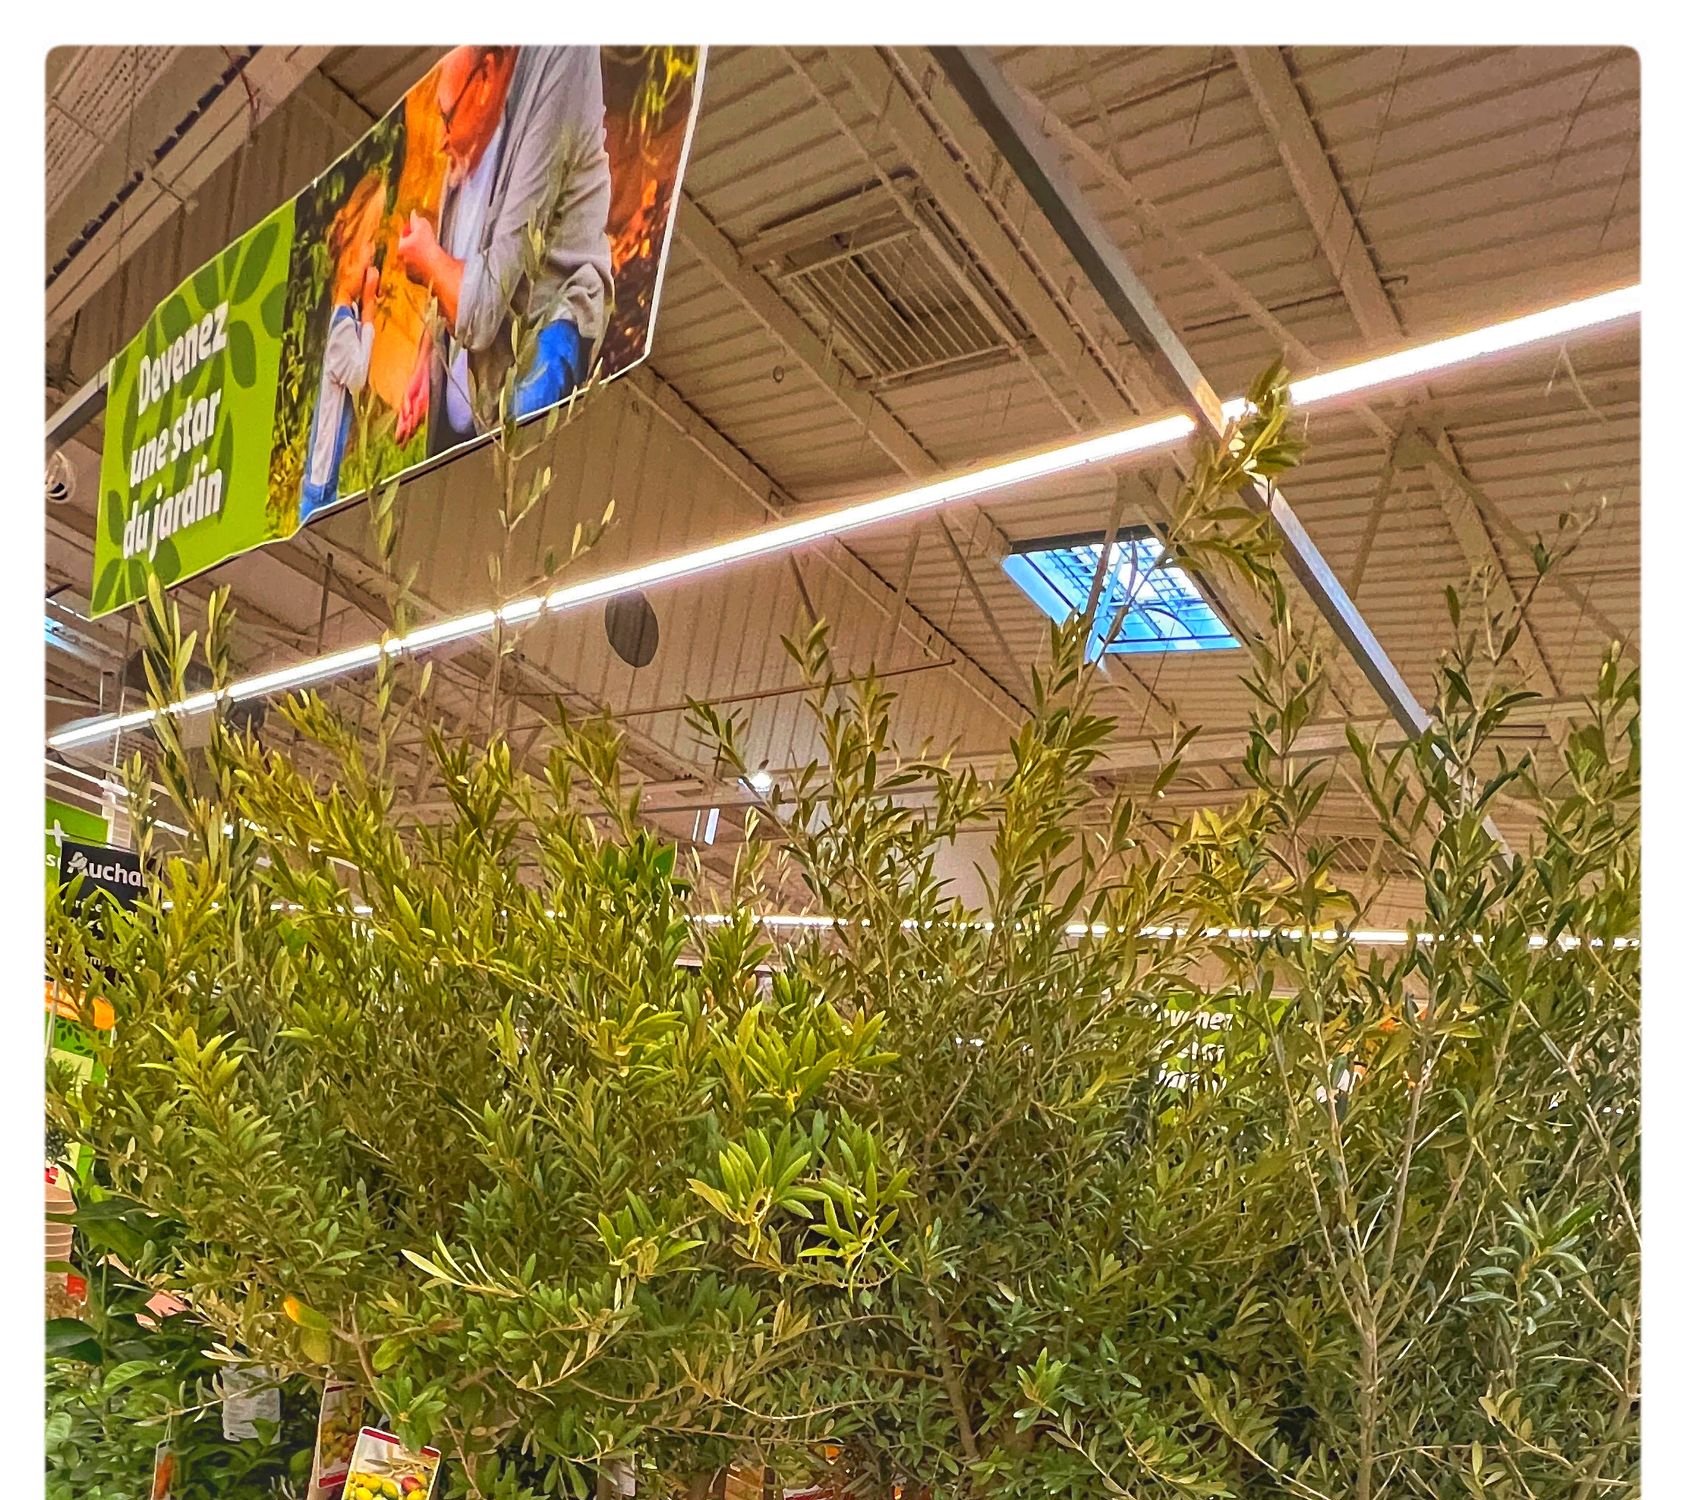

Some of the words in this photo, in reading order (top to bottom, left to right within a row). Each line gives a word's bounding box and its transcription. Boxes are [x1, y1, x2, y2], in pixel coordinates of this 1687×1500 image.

[138, 300, 229, 417] Devenez
[130, 427, 169, 487] une
[170, 388, 222, 463] star
[123, 500, 151, 560] du
[148, 455, 223, 563] jardin
